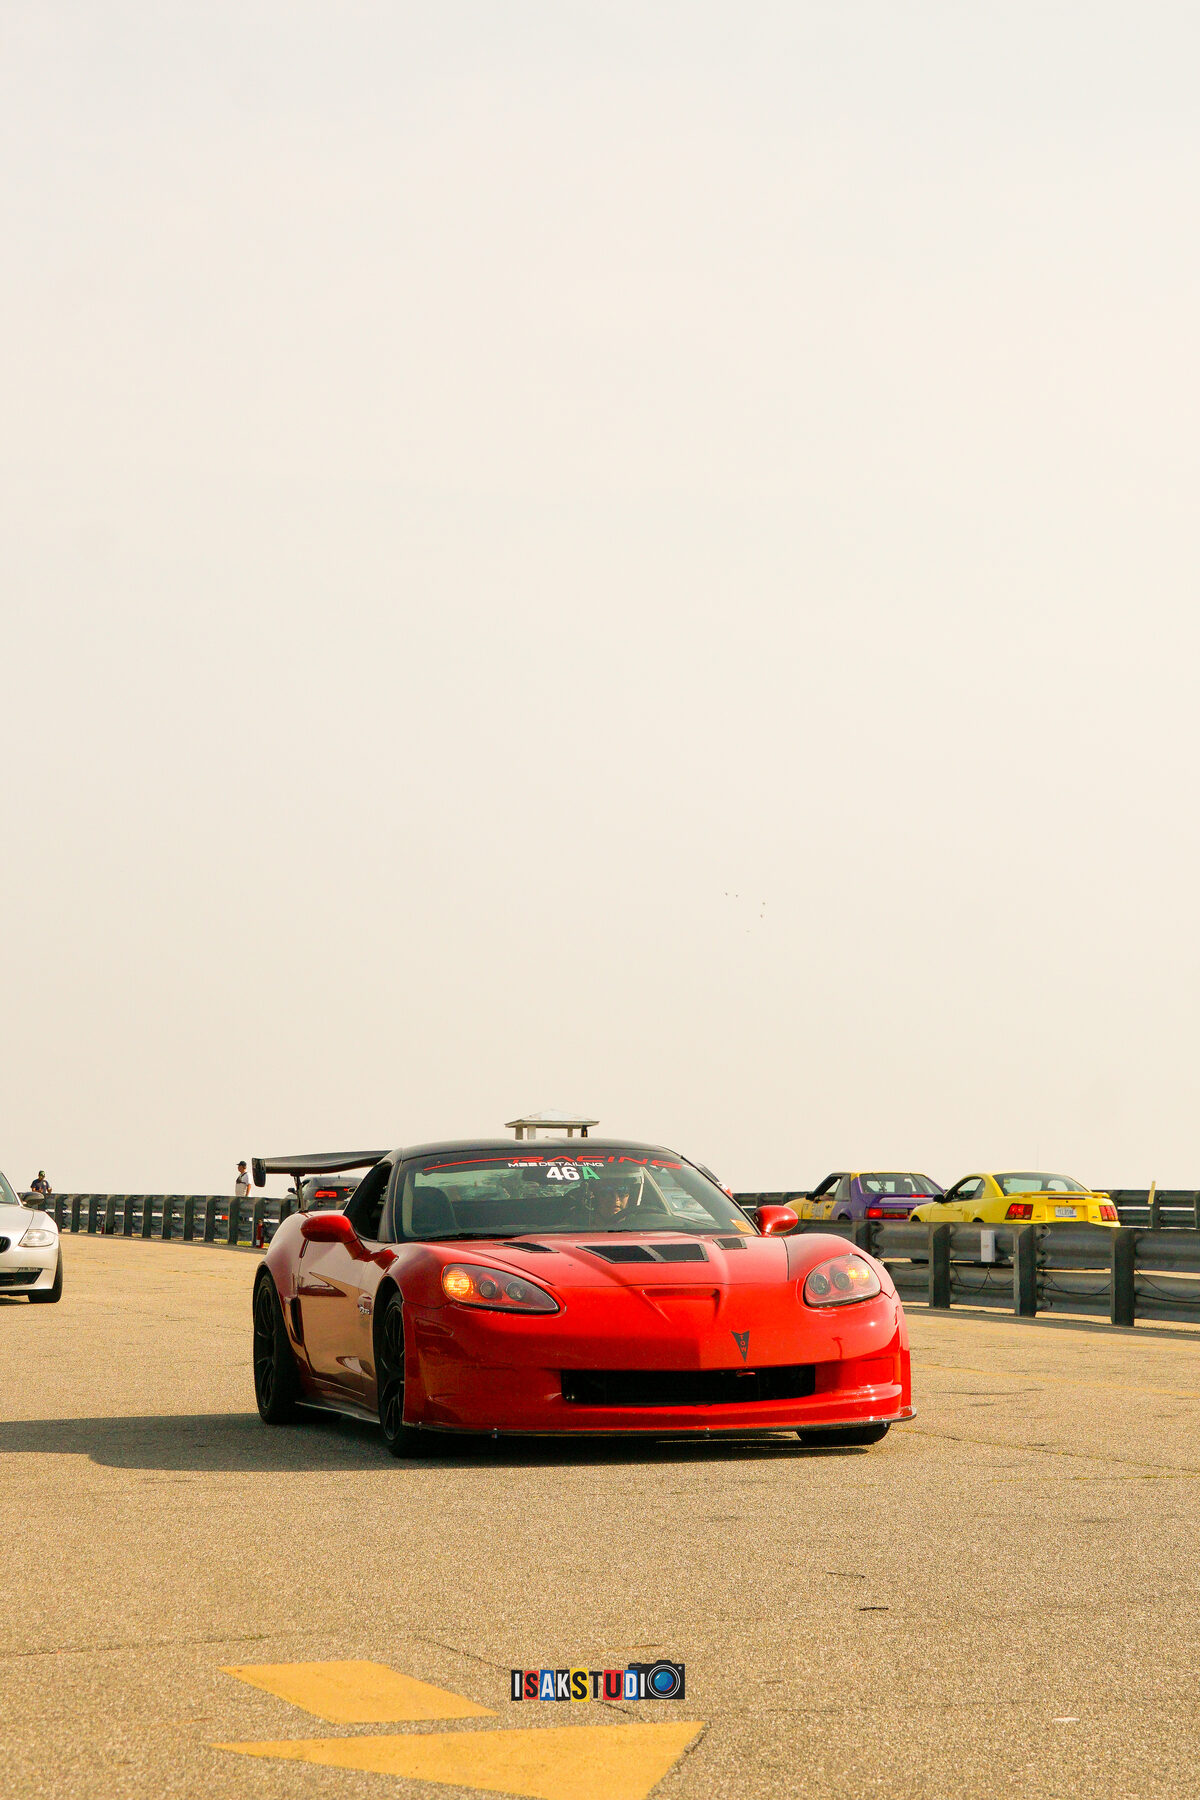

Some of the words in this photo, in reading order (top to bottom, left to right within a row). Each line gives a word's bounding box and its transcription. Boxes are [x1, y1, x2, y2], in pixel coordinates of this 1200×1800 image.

[505, 1155, 682, 1170] RACING
[546, 1166, 580, 1181] 46
[581, 1166, 601, 1180] A
